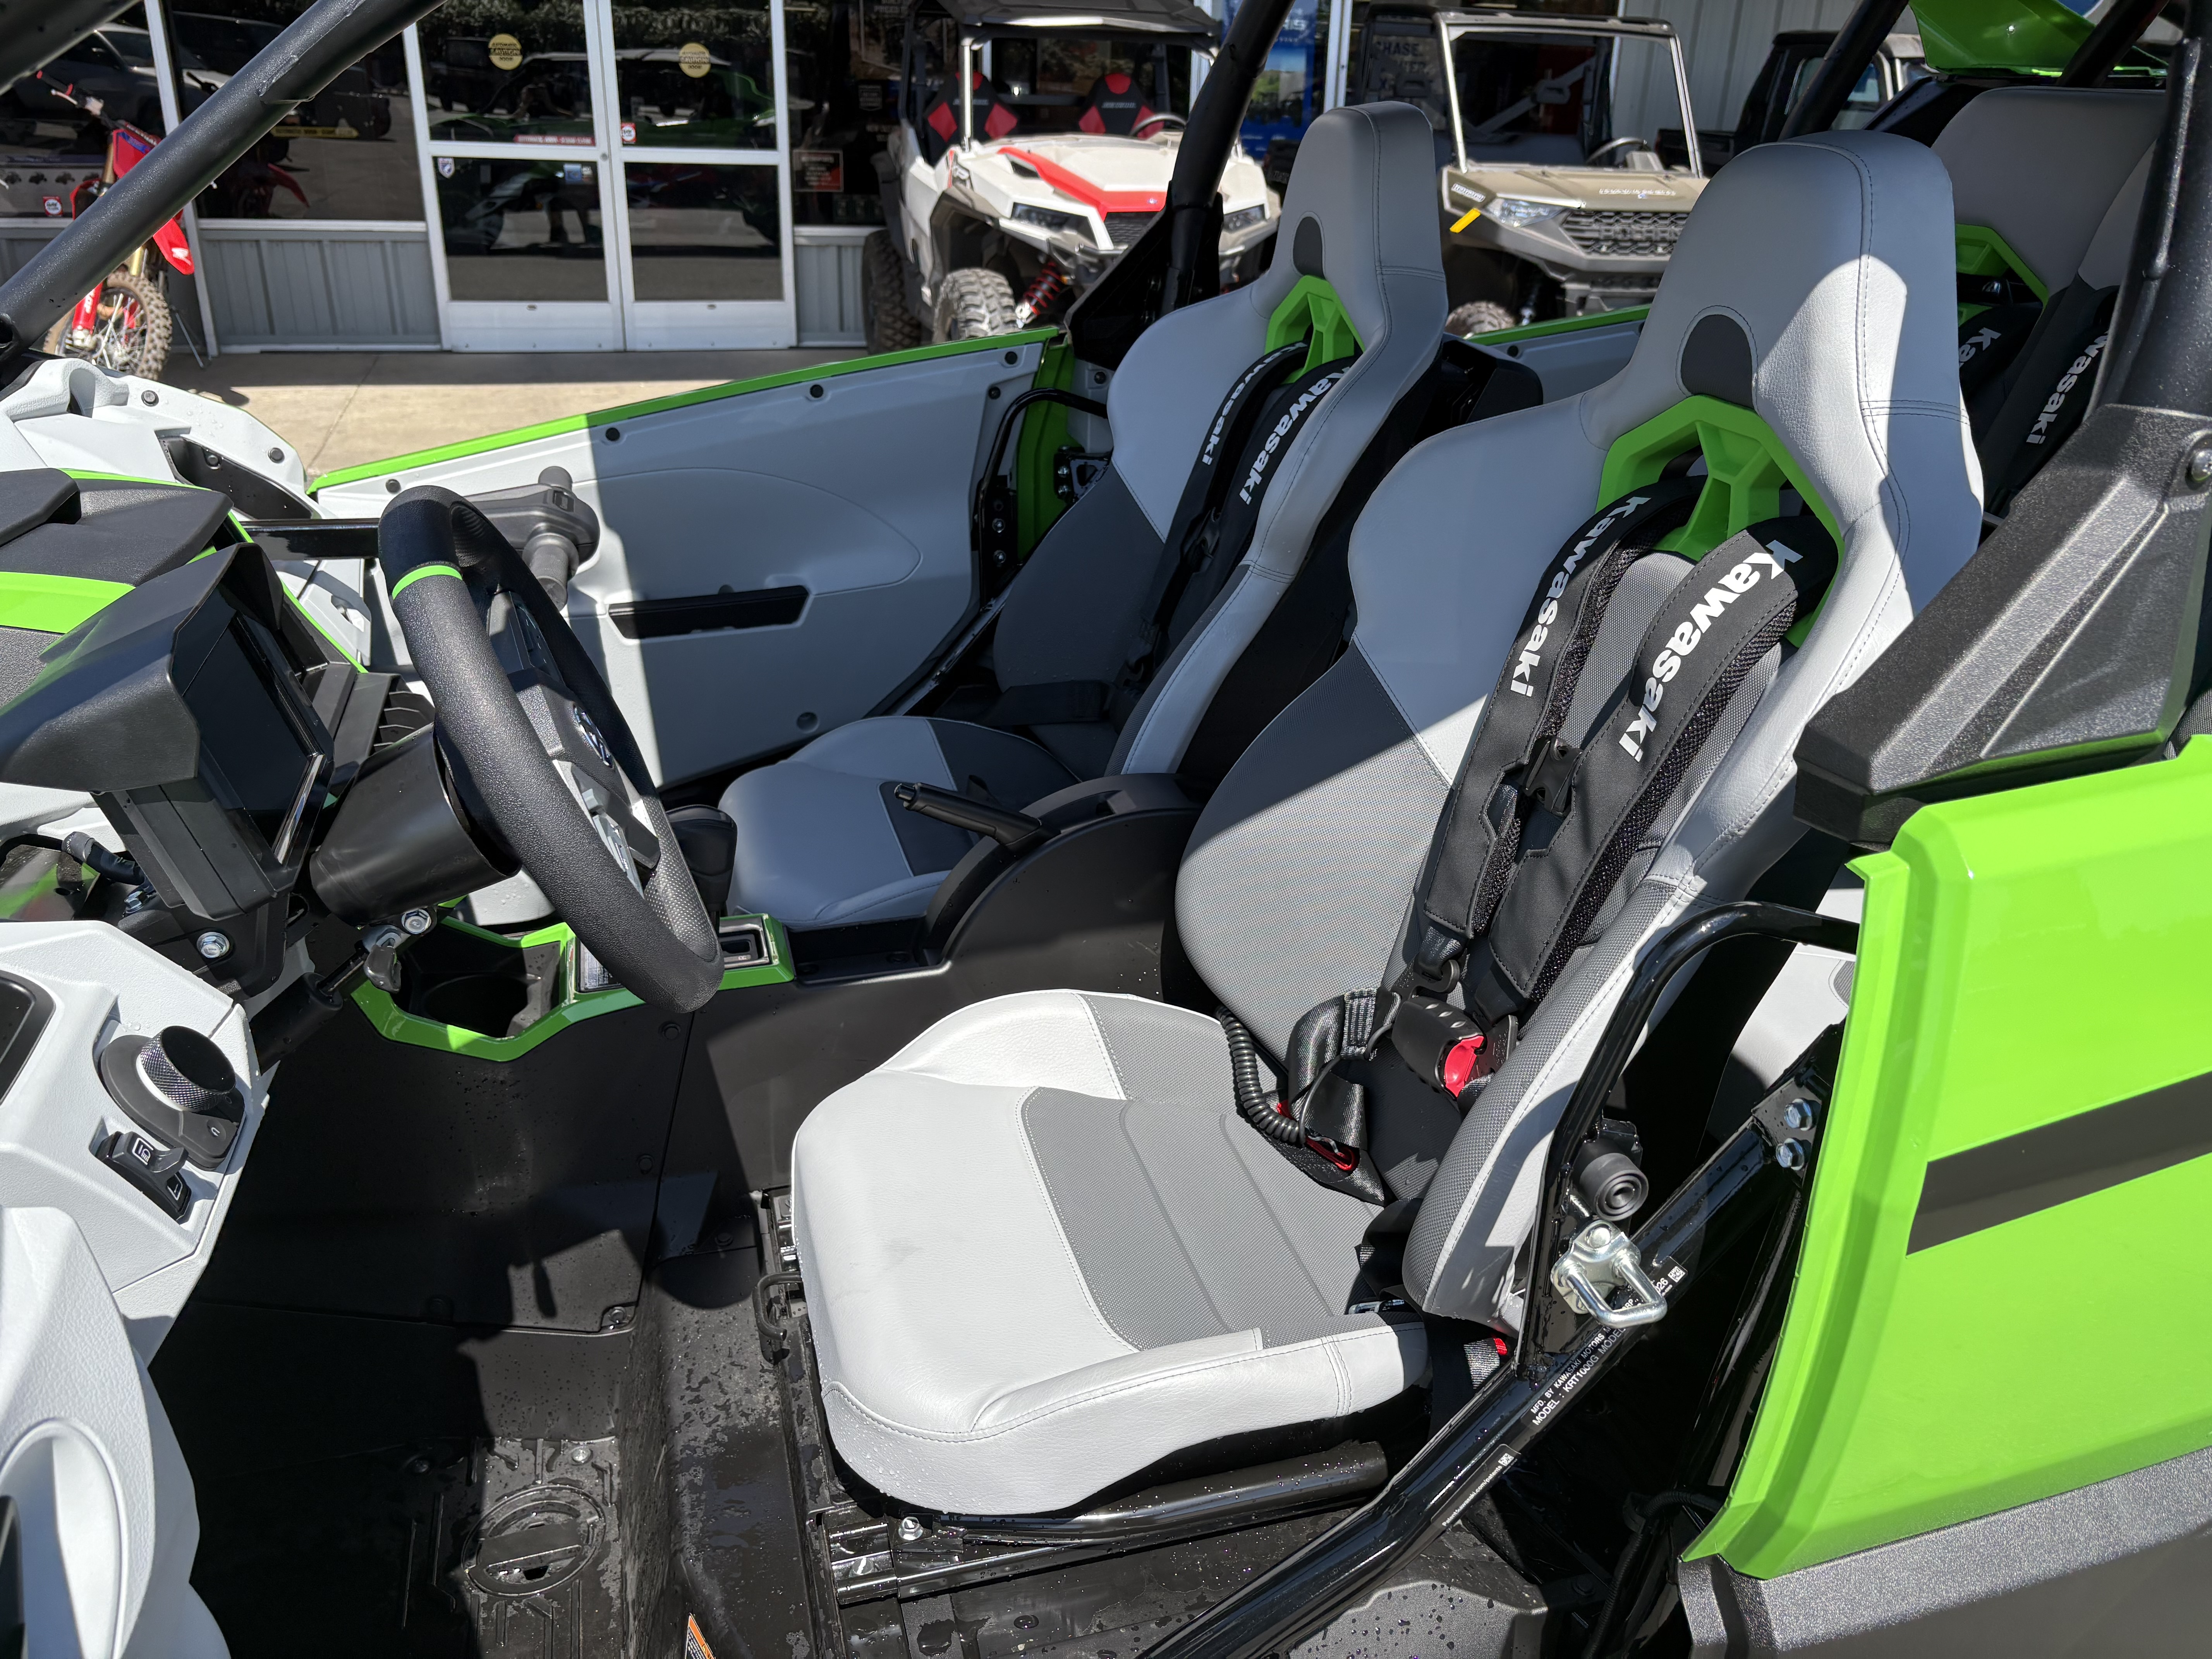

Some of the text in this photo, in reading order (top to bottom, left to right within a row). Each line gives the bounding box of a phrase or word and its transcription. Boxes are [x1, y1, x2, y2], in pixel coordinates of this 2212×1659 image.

[1202, 342, 1307, 465] Kawasaki
[2026, 330, 2108, 445] wasaki
[1510, 496, 1651, 697] Kawasaki
[1619, 540, 1803, 762] Kawasaki
[1530, 1400, 1546, 1414] MFD.
[1544, 1388, 1554, 1398] BY
[1553, 1358, 1582, 1388] KAWASAKI
[1581, 1333, 1605, 1359] MOTORS
[1532, 1399, 1560, 1425] MODEL
[1563, 1355, 1599, 1392] KRT1000G
[1598, 1328, 1626, 1354] MODEL
